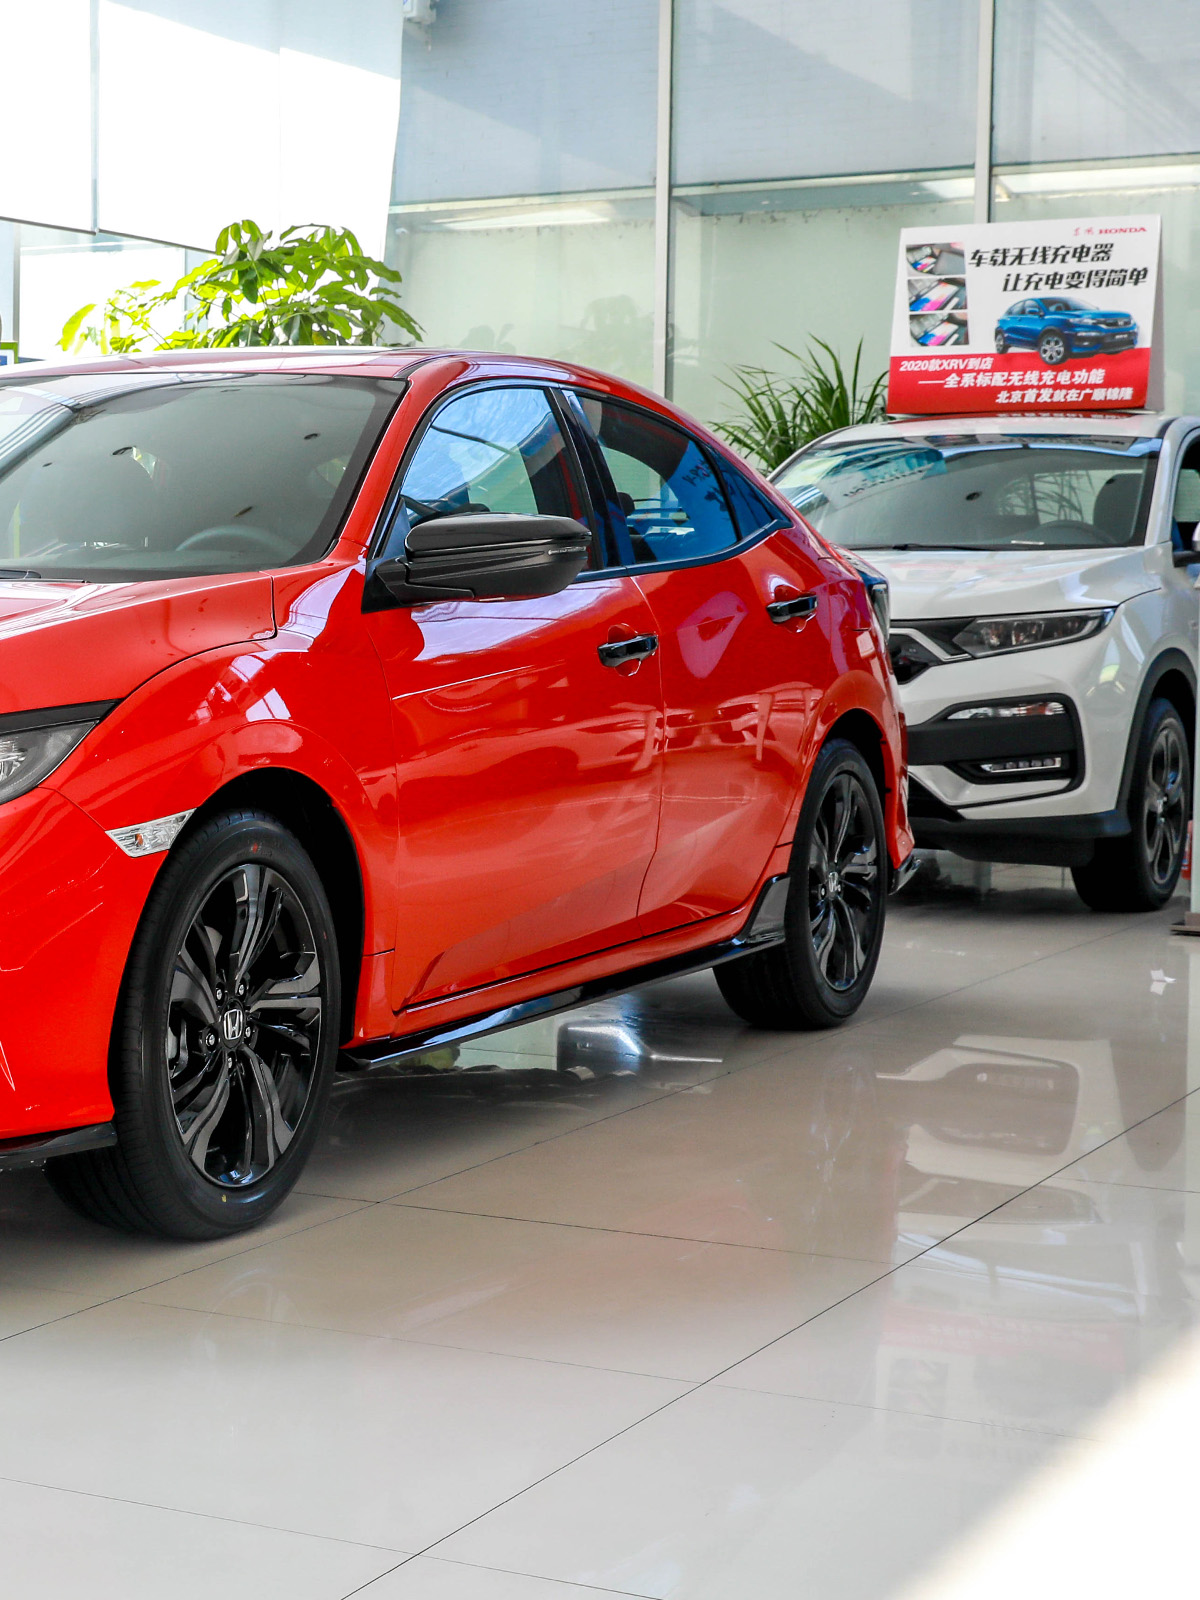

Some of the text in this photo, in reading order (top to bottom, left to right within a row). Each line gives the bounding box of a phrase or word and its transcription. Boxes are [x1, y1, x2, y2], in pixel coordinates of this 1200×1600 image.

[1099, 227, 1148, 235] HONDA
[968, 242, 1115, 268] 车载无线充电器
[1002, 267, 1149, 293] 让充电变得简单
[900, 358, 994, 371] 2020款XRV到店
